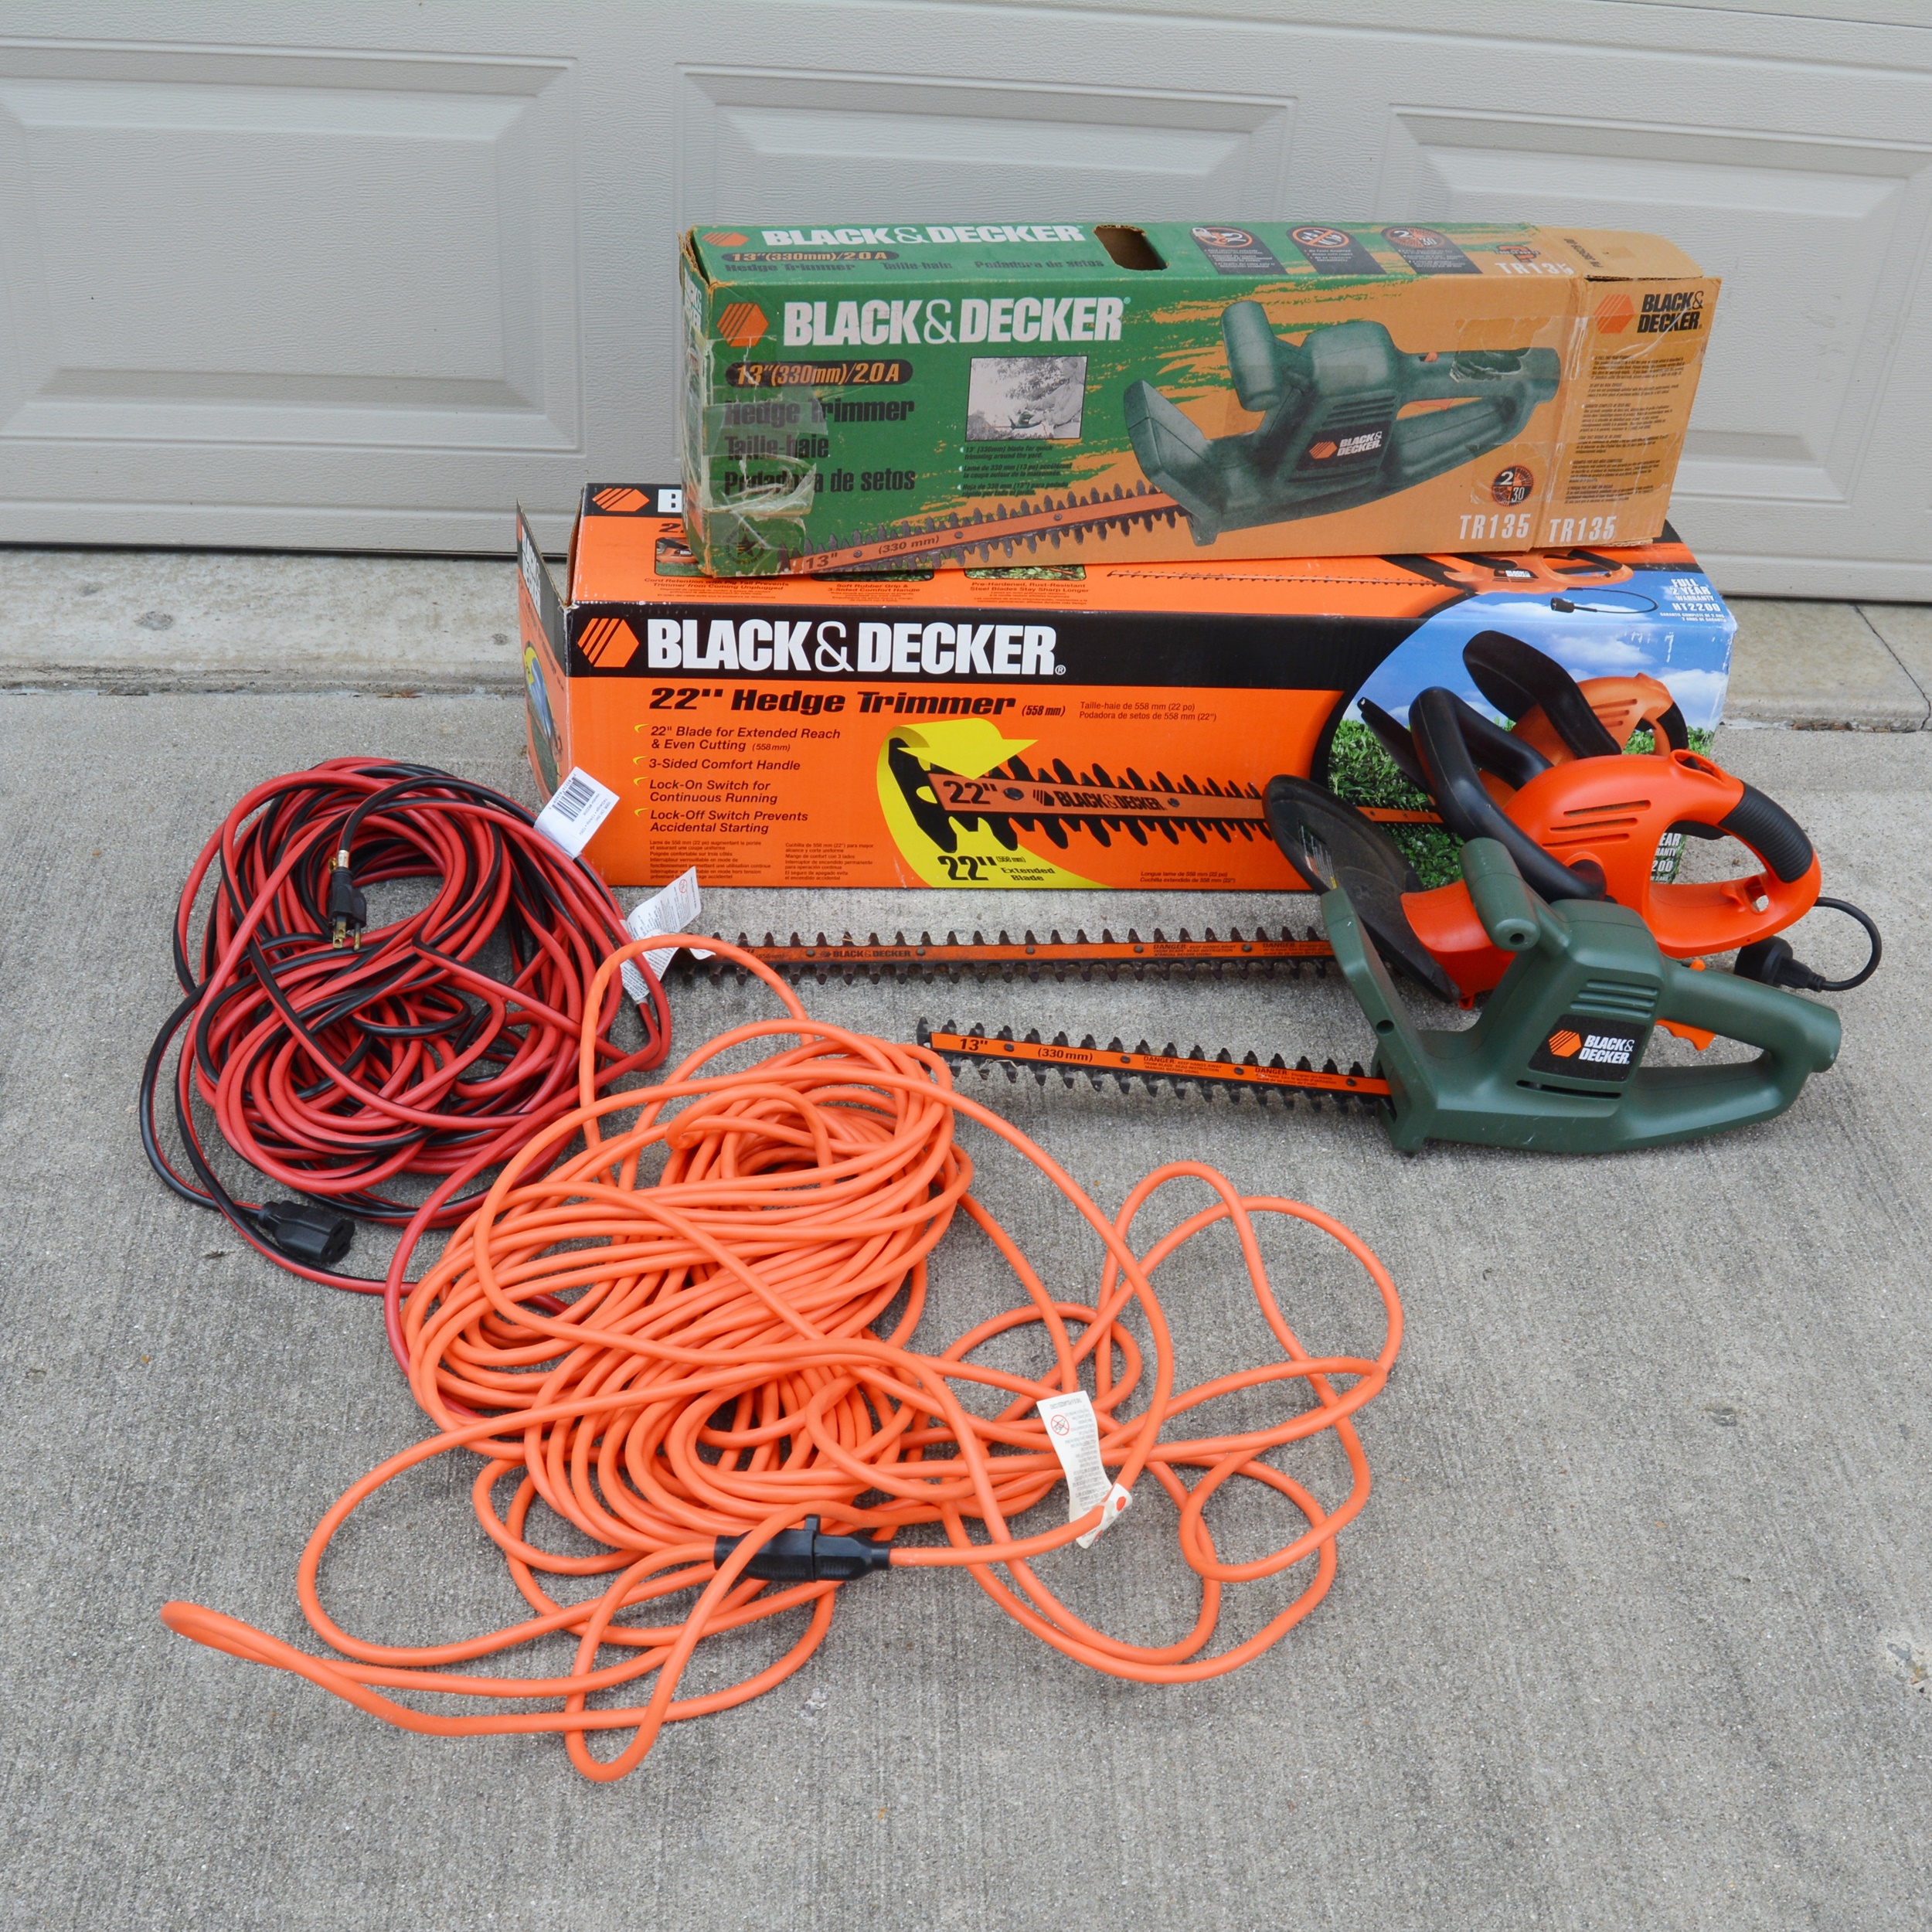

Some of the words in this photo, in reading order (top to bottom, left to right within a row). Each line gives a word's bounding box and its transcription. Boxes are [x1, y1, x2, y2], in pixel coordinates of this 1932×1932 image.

[784, 263, 855, 271] Trimmer
[883, 261, 952, 270] Taille-haie
[975, 260, 1043, 269] Podadora
[1046, 260, 1062, 268] de
[1637, 311, 1700, 333] DECKER
[724, 399, 800, 427] Hedge
[808, 397, 914, 423] Trimmer
[724, 434, 829, 461] Taille-haie
[831, 468, 854, 492] de
[861, 468, 915, 492] setos
[1500, 471, 1514, 485] 2
[1512, 487, 1525, 502] 30
[1460, 514, 1531, 539] TR135
[1549, 515, 1617, 542] TR135
[805, 553, 838, 569] 13"
[879, 542, 906, 554] (330
[911, 536, 940, 548] mm)
[1671, 579, 1699, 587] FULL
[1680, 587, 1711, 595] YEAR
[648, 687, 723, 710] 22"
[731, 689, 845, 715] Hedge
[857, 692, 1016, 715] Trimmer
[1022, 705, 1043, 716] (558
[1045, 706, 1066, 716] mm)
[1168, 702, 1181, 711] (22
[1182, 703, 1195, 712] po)
[1080, 711, 1116, 719] Podadora
[1197, 713, 1216, 722] (22")
[651, 726, 672, 736] 22"
[676, 726, 712, 736] Blade
[716, 727, 734, 737] for
[737, 727, 798, 738] Extended
[801, 729, 841, 739] Reach
[651, 740, 660, 749] &
[664, 740, 695, 750] Even
[699, 740, 747, 752] Cutting
[649, 759, 698, 769] 3-Sided
[701, 759, 753, 770] Comfort
[756, 760, 801, 770] Handle
[649, 780, 702, 790] Lock-On
[706, 780, 749, 790] Switch
[753, 781, 770, 791] for
[650, 792, 722, 802] Continuous
[726, 794, 777, 805] Running
[943, 781, 998, 804] 22"
[650, 810, 705, 821] Lock-Off
[708, 811, 750, 821] Switch
[753, 811, 808, 821] Prevents
[650, 822, 716, 832] Accidental
[719, 823, 769, 835] Starting
[1659, 833, 1682, 846] EAR
[937, 855, 998, 881] 22"
[1584, 1035, 1634, 1052] BLACK&
[960, 1039, 988, 1051] 13"
[1037, 1049, 1063, 1058] (330
[1066, 1051, 1093, 1062] mm)
[1579, 1047, 1629, 1064] DECKER
